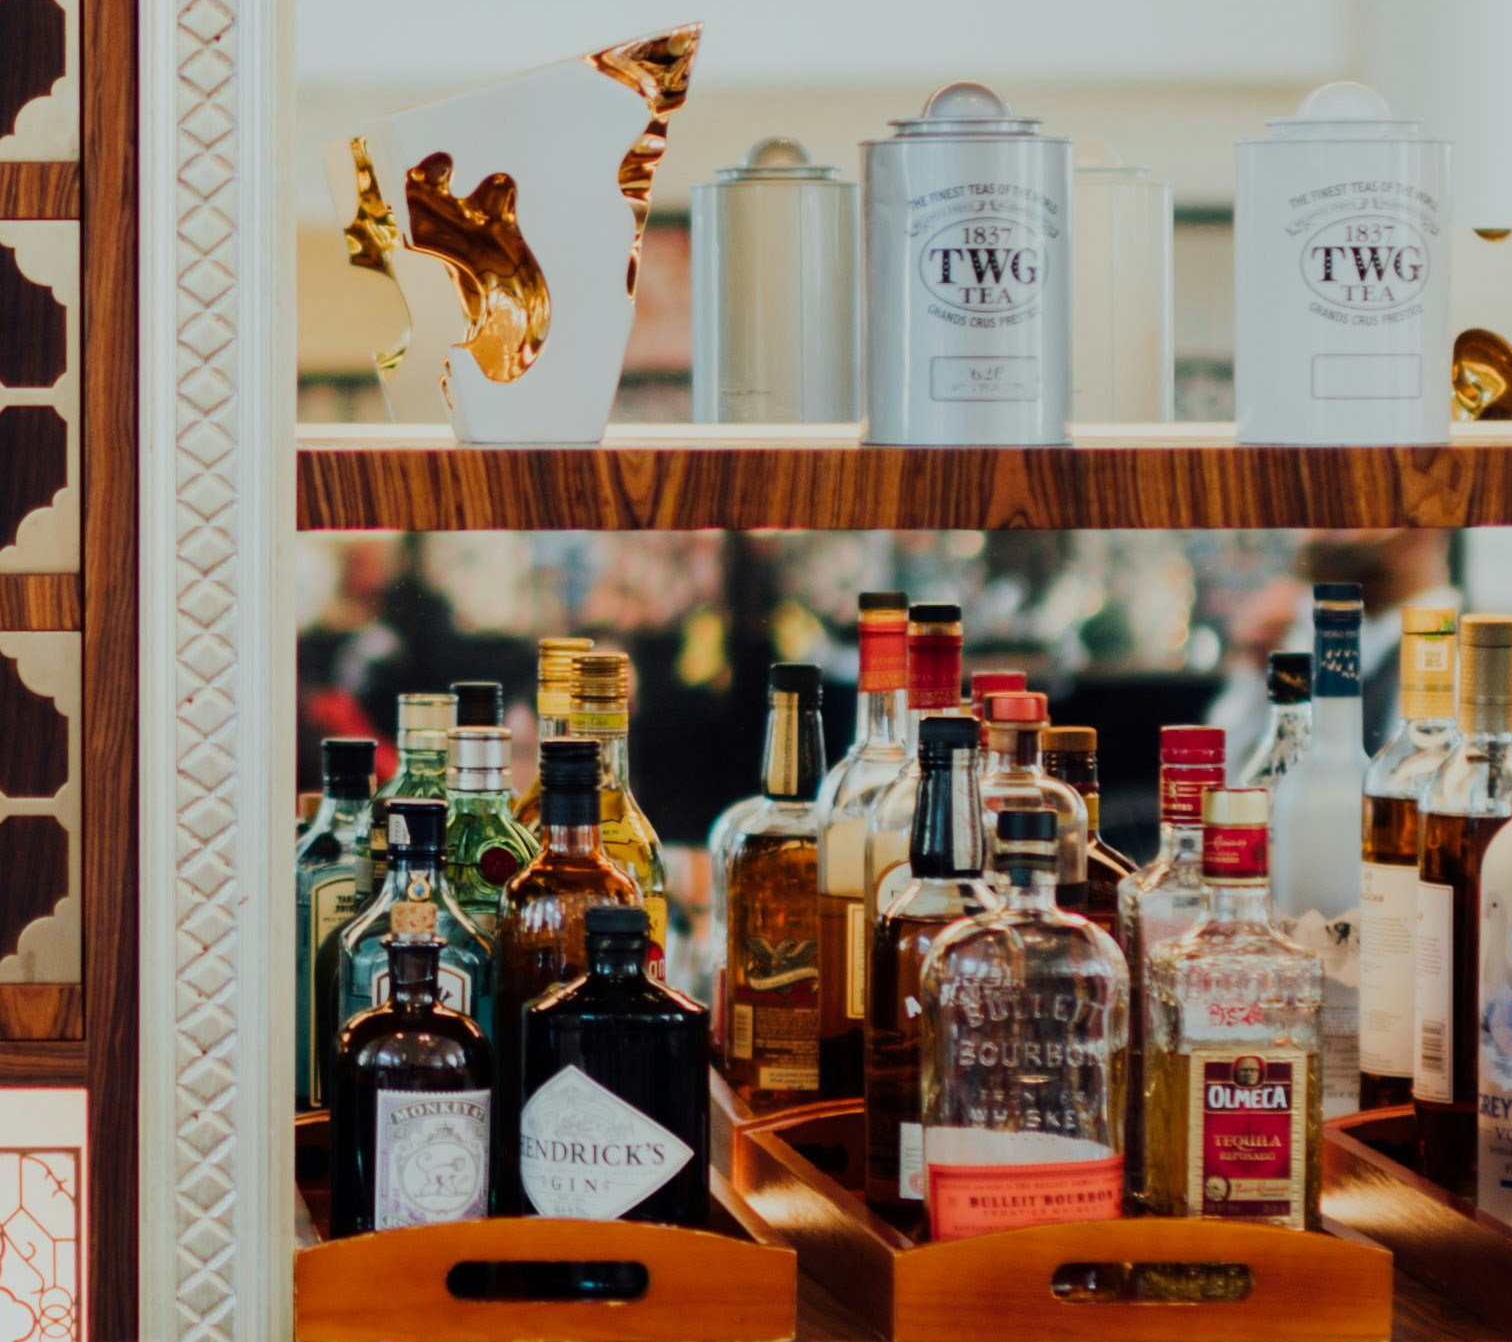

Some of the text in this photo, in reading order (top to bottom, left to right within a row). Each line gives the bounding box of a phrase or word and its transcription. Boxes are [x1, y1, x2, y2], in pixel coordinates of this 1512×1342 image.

[907, 197, 928, 211] THE
[929, 186, 964, 204] FINEST
[969, 183, 995, 195] TEAS
[998, 184, 1011, 195] OF
[1289, 193, 1309, 209] THE
[1311, 183, 1347, 201] FINEST
[1350, 181, 1378, 193] TEAS
[1381, 181, 1394, 193] OF
[962, 226, 1012, 246] 1837
[1345, 224, 1395, 243] 1837
[929, 247, 1039, 285] TWG
[1311, 245, 1423, 282] TWG
[958, 287, 1013, 304] TEA
[1340, 285, 1396, 302] TEA
[927, 303, 967, 327] GRANDS
[969, 316, 997, 329] CRUS
[1309, 301, 1349, 325] GRANDS
[1352, 314, 1379, 326] CRUS
[1208, 1085, 1288, 1108] OLMECA
[393, 1101, 472, 1123] MONKEY
[1213, 1134, 1282, 1151] TEQUILA
[551, 1175, 597, 1194] GIN
[970, 1190, 1113, 1208] BULLEIT BOURBON
